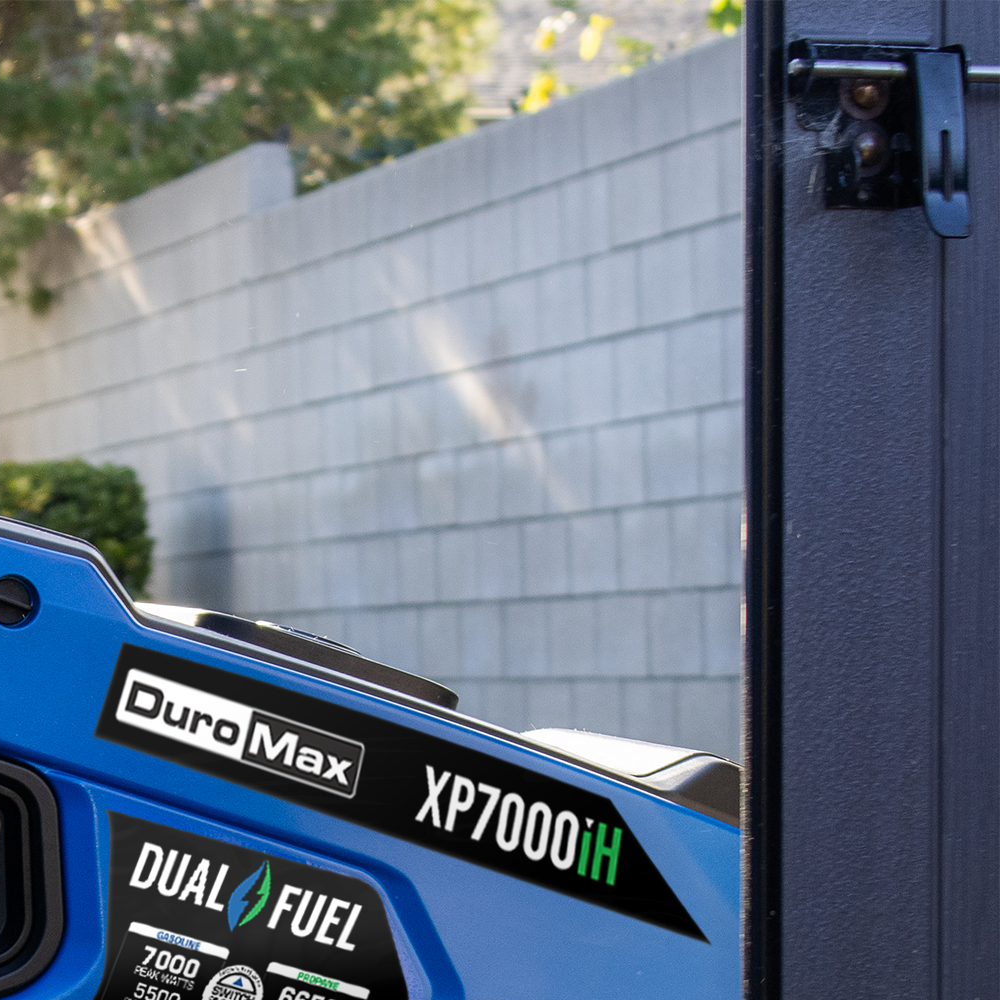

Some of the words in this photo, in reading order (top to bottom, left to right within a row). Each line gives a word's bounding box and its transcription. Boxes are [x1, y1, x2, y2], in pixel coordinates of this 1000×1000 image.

[125, 680, 353, 786] DuroMax
[415, 764, 623, 886] XP7000iH
[129, 841, 230, 912] DUAL
[267, 884, 362, 951] FUEL
[156, 930, 202, 951] GASOLINE
[133, 964, 161, 981] PEAK
[141, 944, 201, 979] 7000
[296, 971, 341, 991] PROPANE
